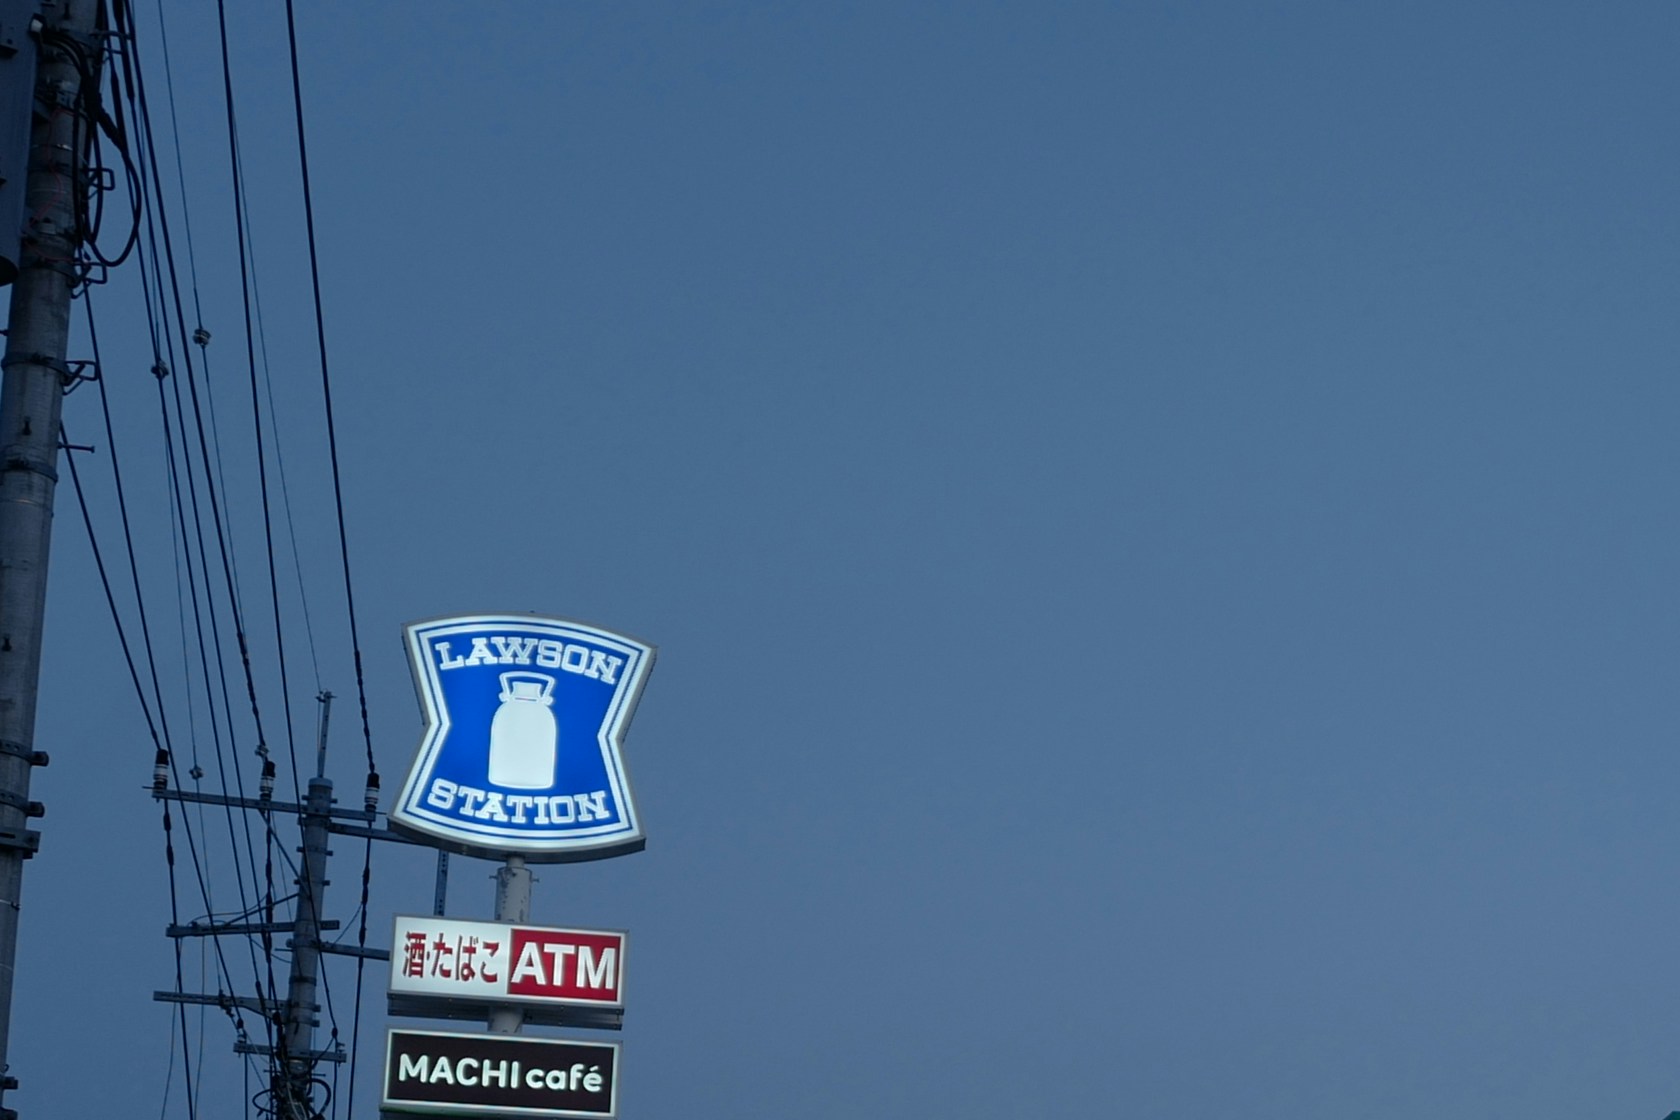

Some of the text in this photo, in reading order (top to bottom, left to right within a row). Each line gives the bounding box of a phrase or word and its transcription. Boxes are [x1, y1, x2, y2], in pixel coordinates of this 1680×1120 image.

[435, 636, 622, 685] LAWSON
[427, 777, 610, 824] STATION
[511, 941, 616, 990] ATM
[399, 1053, 603, 1092] MACHI café
